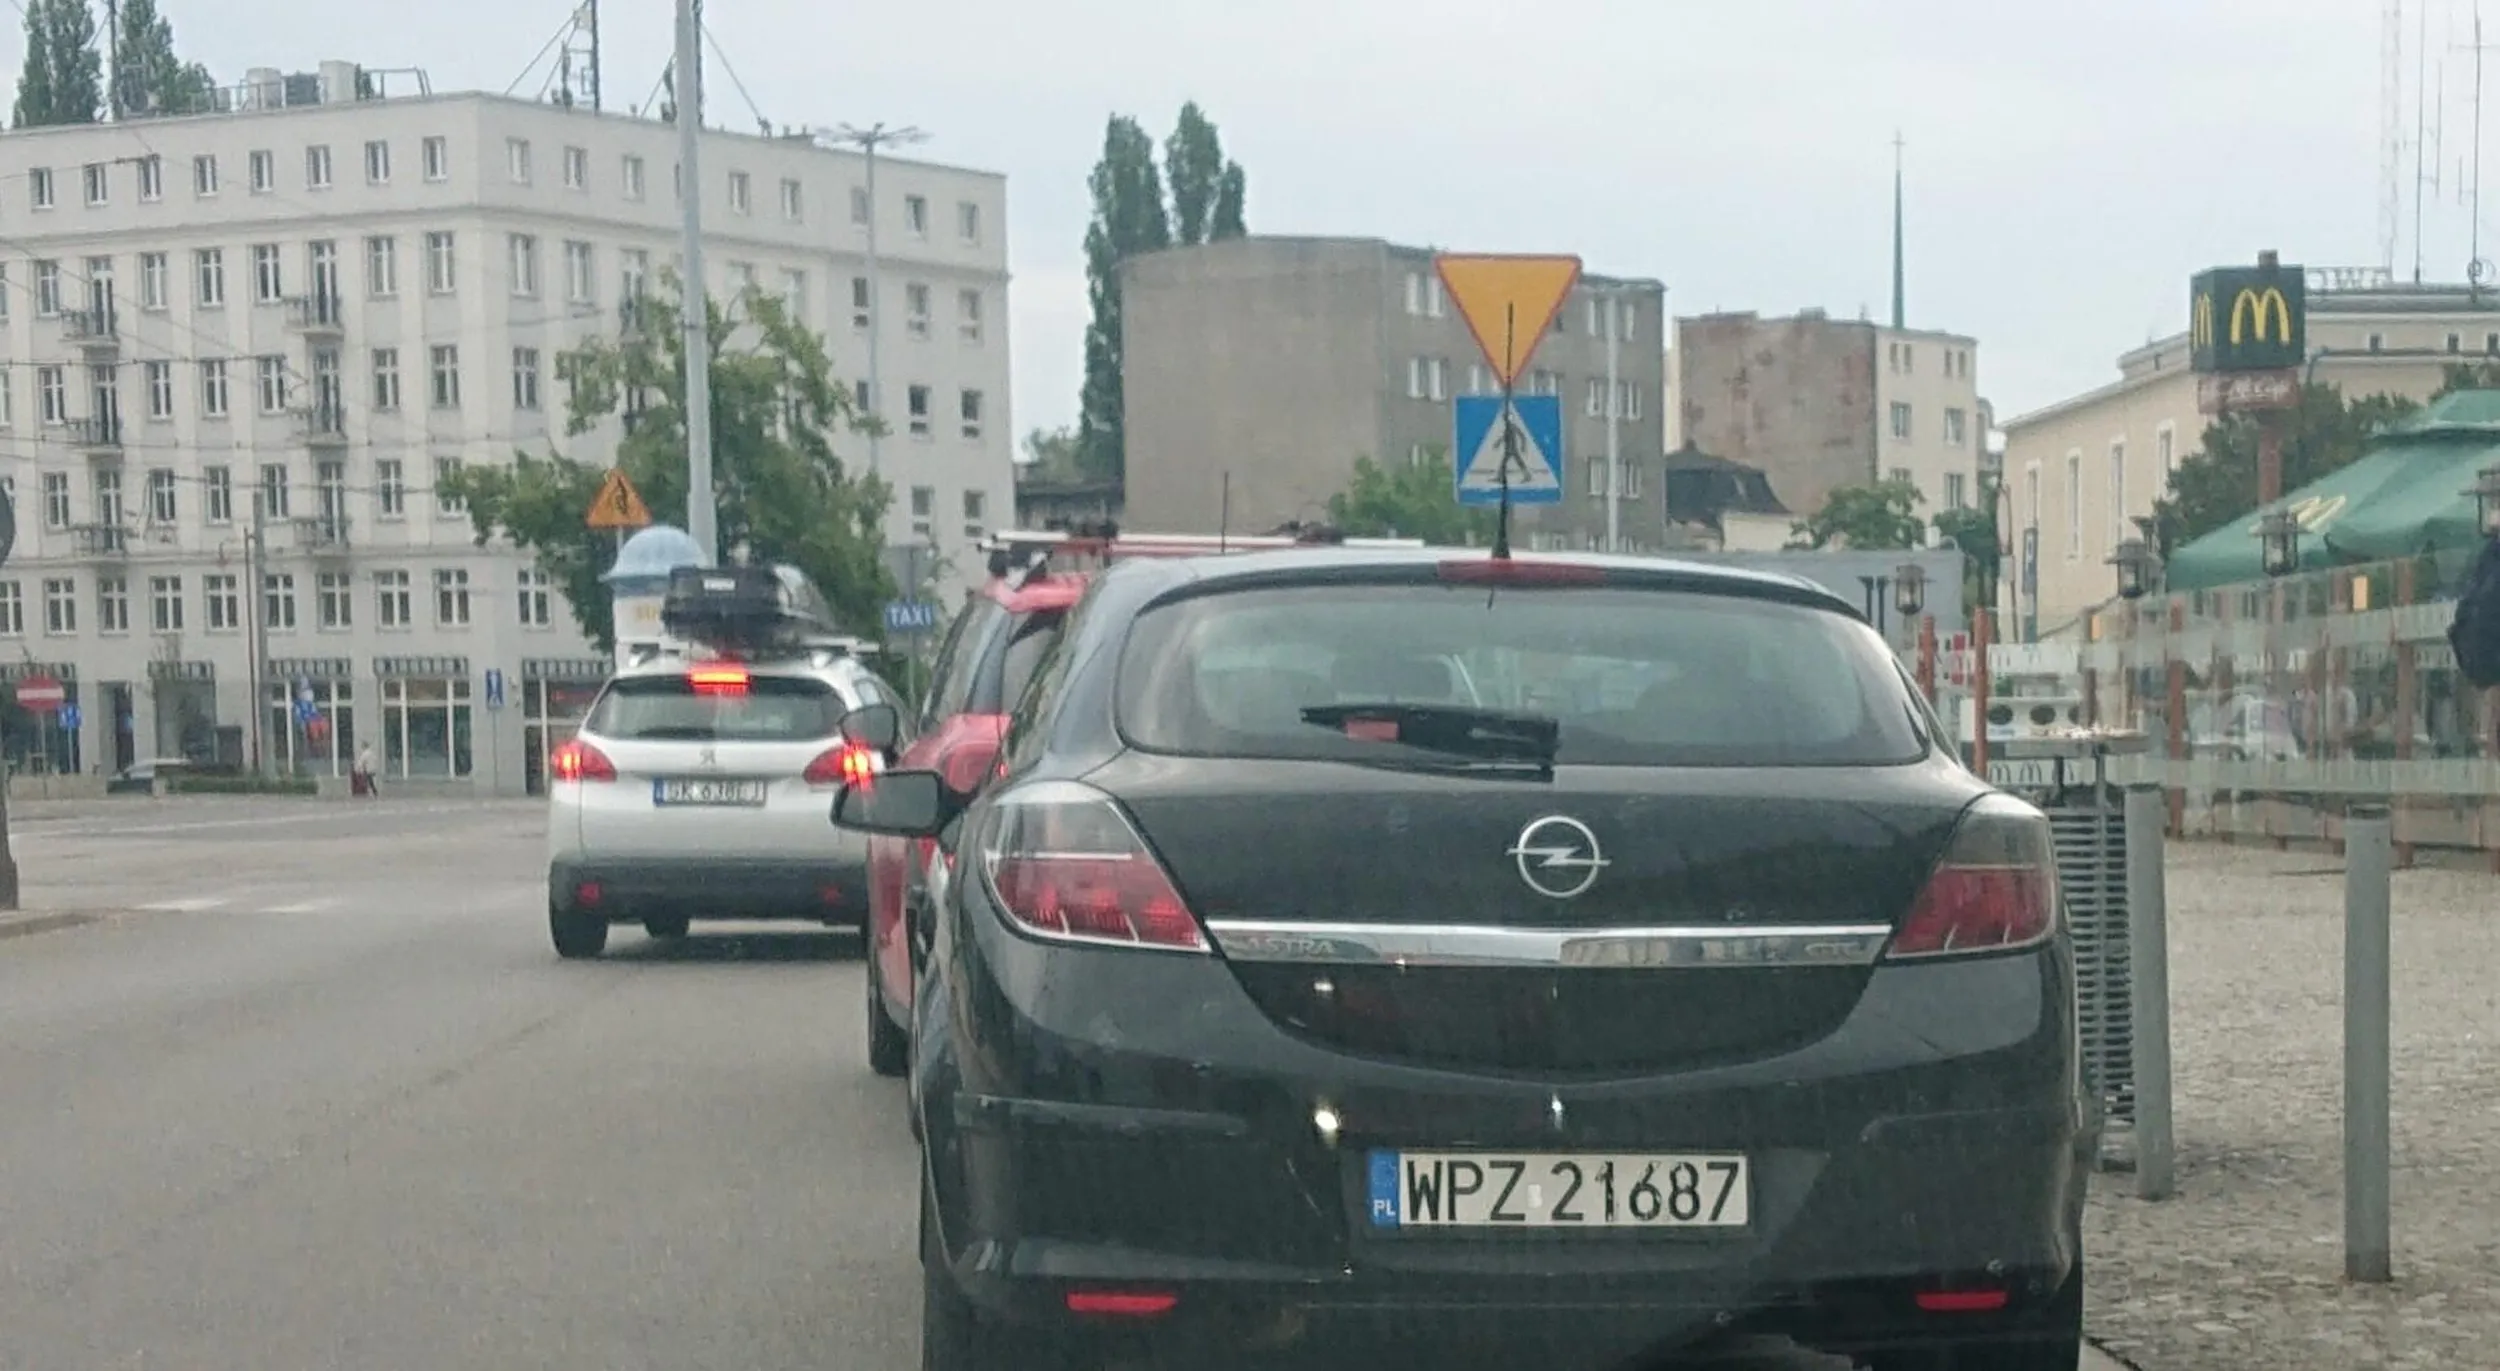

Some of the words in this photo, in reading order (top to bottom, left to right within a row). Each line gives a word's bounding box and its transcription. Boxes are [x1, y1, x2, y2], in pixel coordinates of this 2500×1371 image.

[2231, 287, 2290, 345] M
[888, 606, 933, 626] TAXI
[1246, 938, 1336, 955] ASTRA
[1407, 1160, 1526, 1222] WPZ
[1550, 1160, 1740, 1222] 21687
[1373, 1200, 1396, 1217] PL
